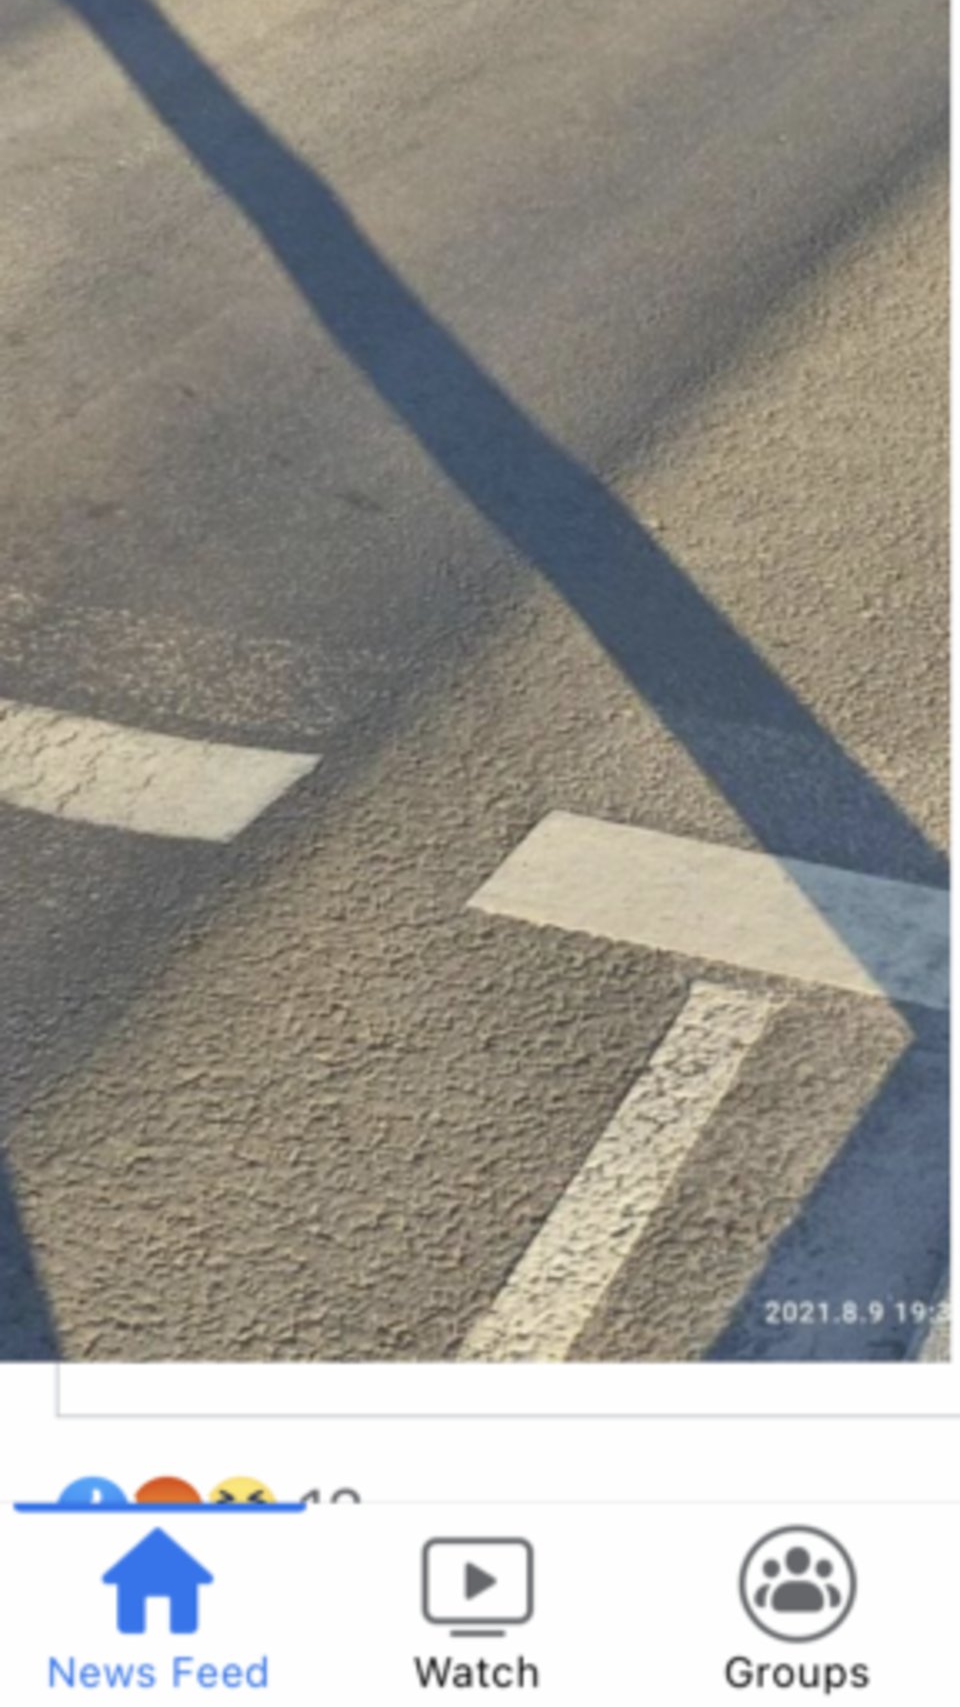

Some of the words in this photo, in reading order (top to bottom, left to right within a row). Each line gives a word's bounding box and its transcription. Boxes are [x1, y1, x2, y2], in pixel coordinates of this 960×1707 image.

[48, 1656, 157, 1689] News
[173, 1655, 268, 1689] Feed
[413, 1655, 539, 1689] Watch
[724, 1655, 870, 1696] Groups
